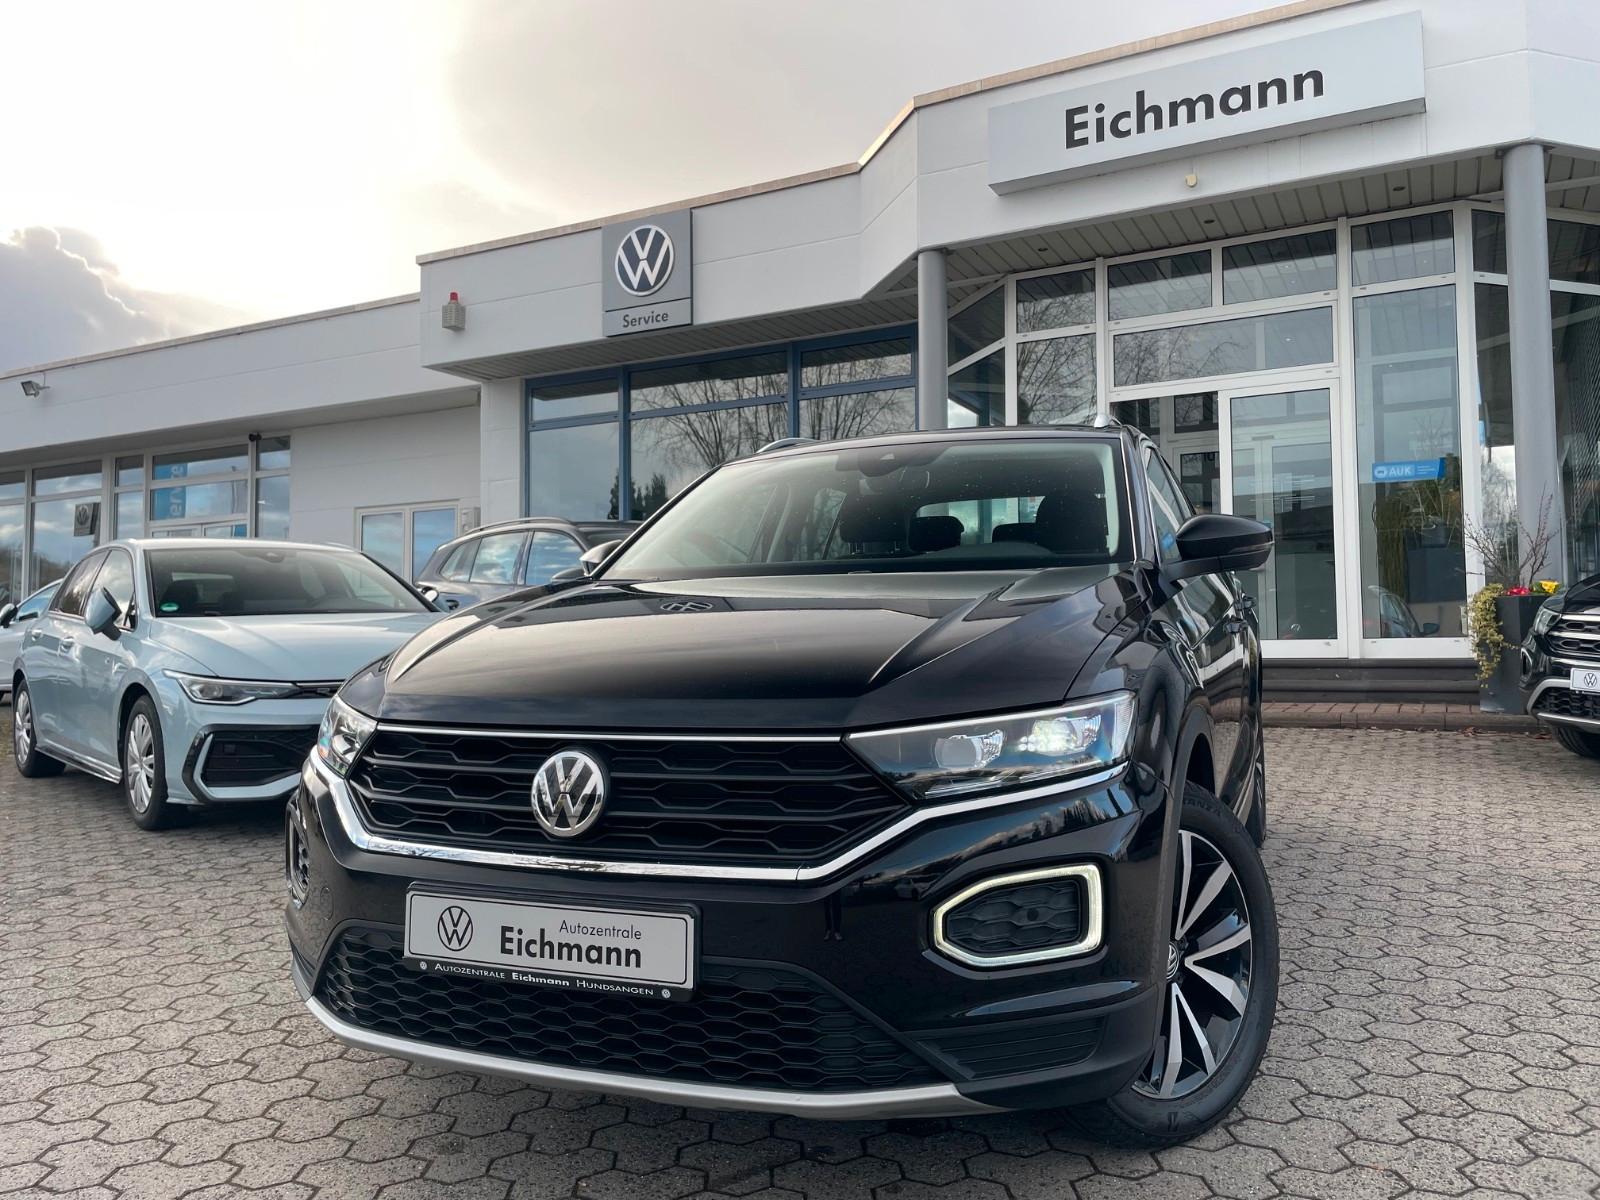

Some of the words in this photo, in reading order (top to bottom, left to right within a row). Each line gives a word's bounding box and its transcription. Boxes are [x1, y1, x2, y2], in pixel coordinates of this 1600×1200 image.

[1065, 69, 1324, 150] Eichmann
[622, 310, 669, 328] Service
[1388, 465, 1413, 477] AUK
[559, 919, 643, 941] Autozentrale
[500, 925, 642, 969] Eichmann
[434, 962, 506, 979] AUTOZENTRALE
[511, 971, 570, 987] Eichmann
[576, 979, 654, 996] HUNDSANGEN
